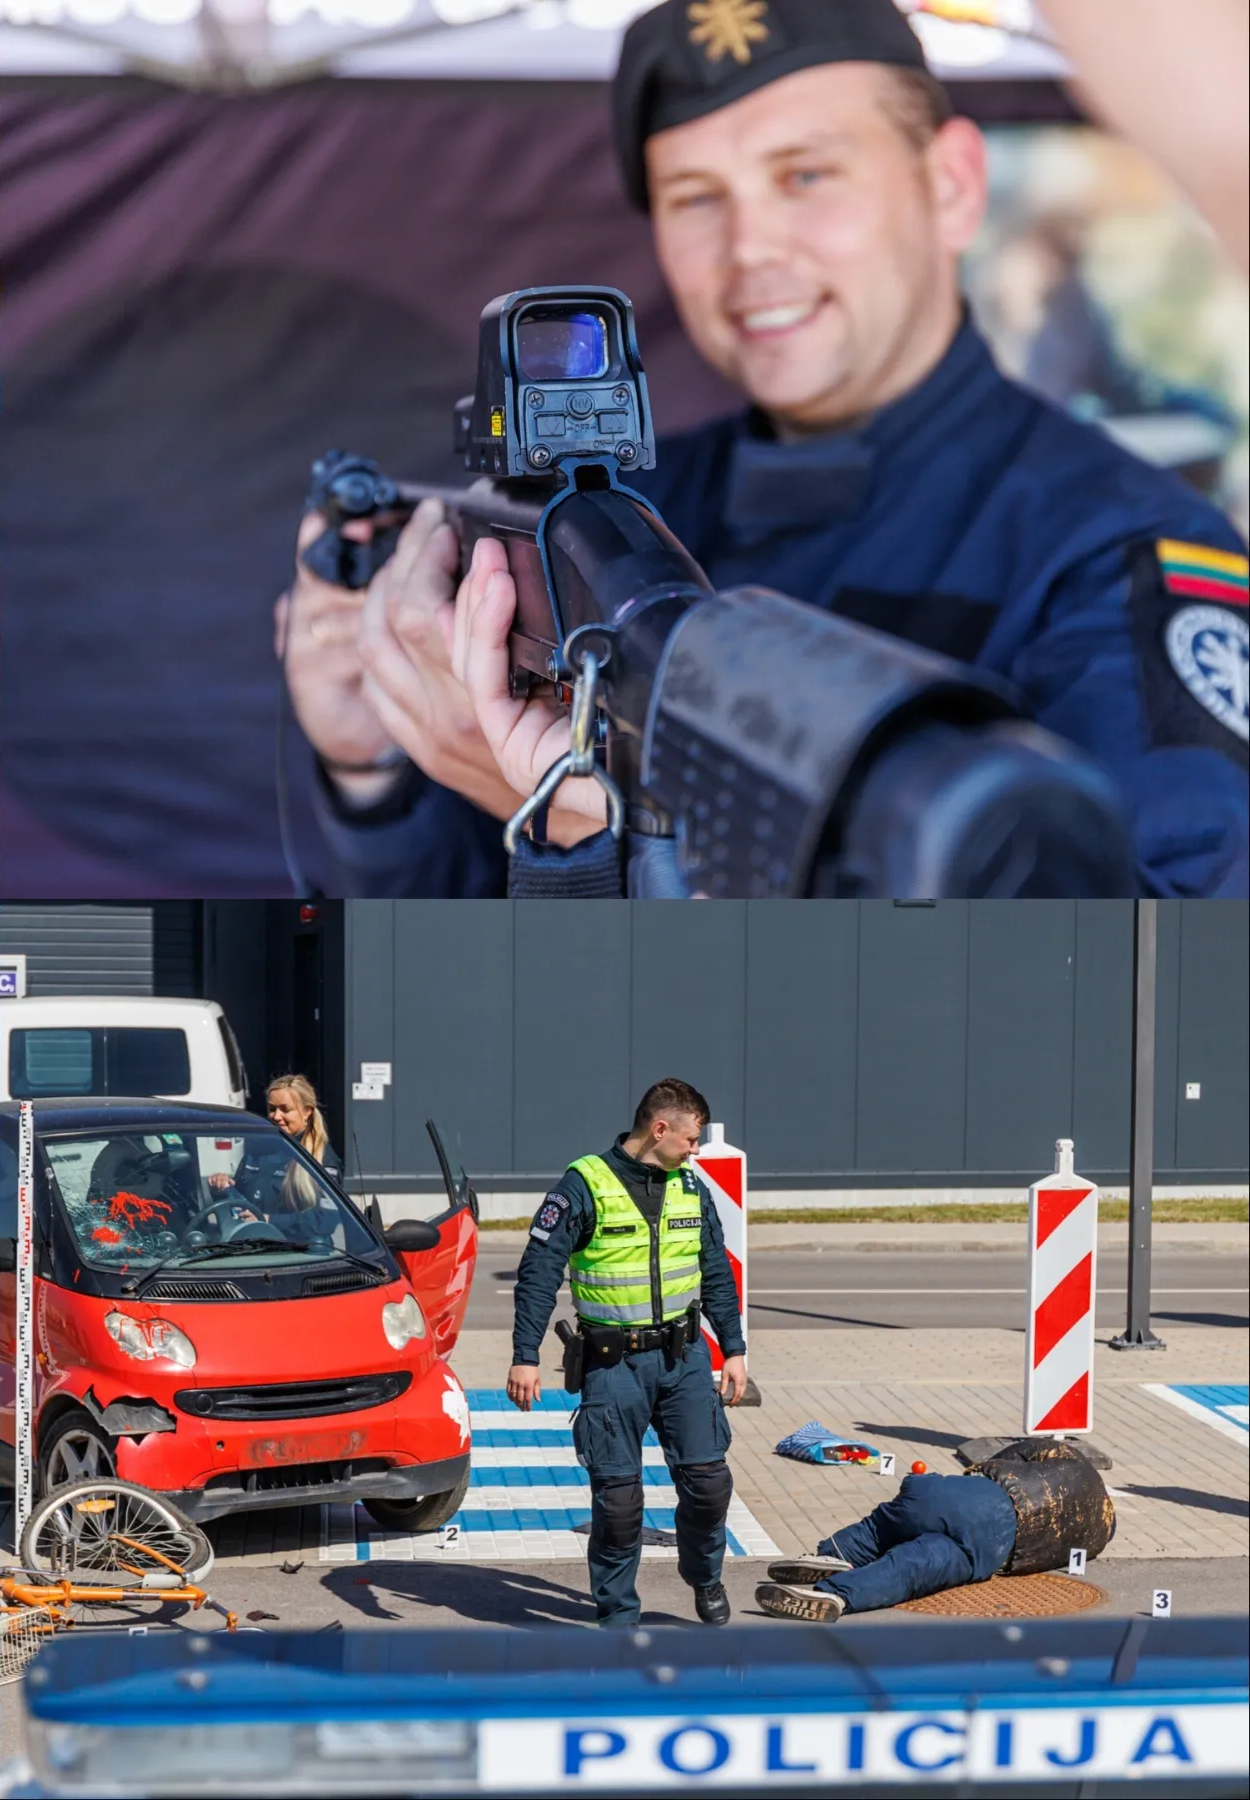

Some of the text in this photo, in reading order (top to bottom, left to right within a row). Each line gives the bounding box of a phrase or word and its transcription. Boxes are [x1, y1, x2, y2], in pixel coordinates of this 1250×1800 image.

[669, 1218, 702, 1228] POLICIJA
[882, 1456, 894, 1469] 7
[445, 1527, 458, 1542] 2
[1072, 1551, 1083, 1567] 1
[1155, 1593, 1169, 1609] 3
[562, 1715, 1193, 1776] POLICIJA
